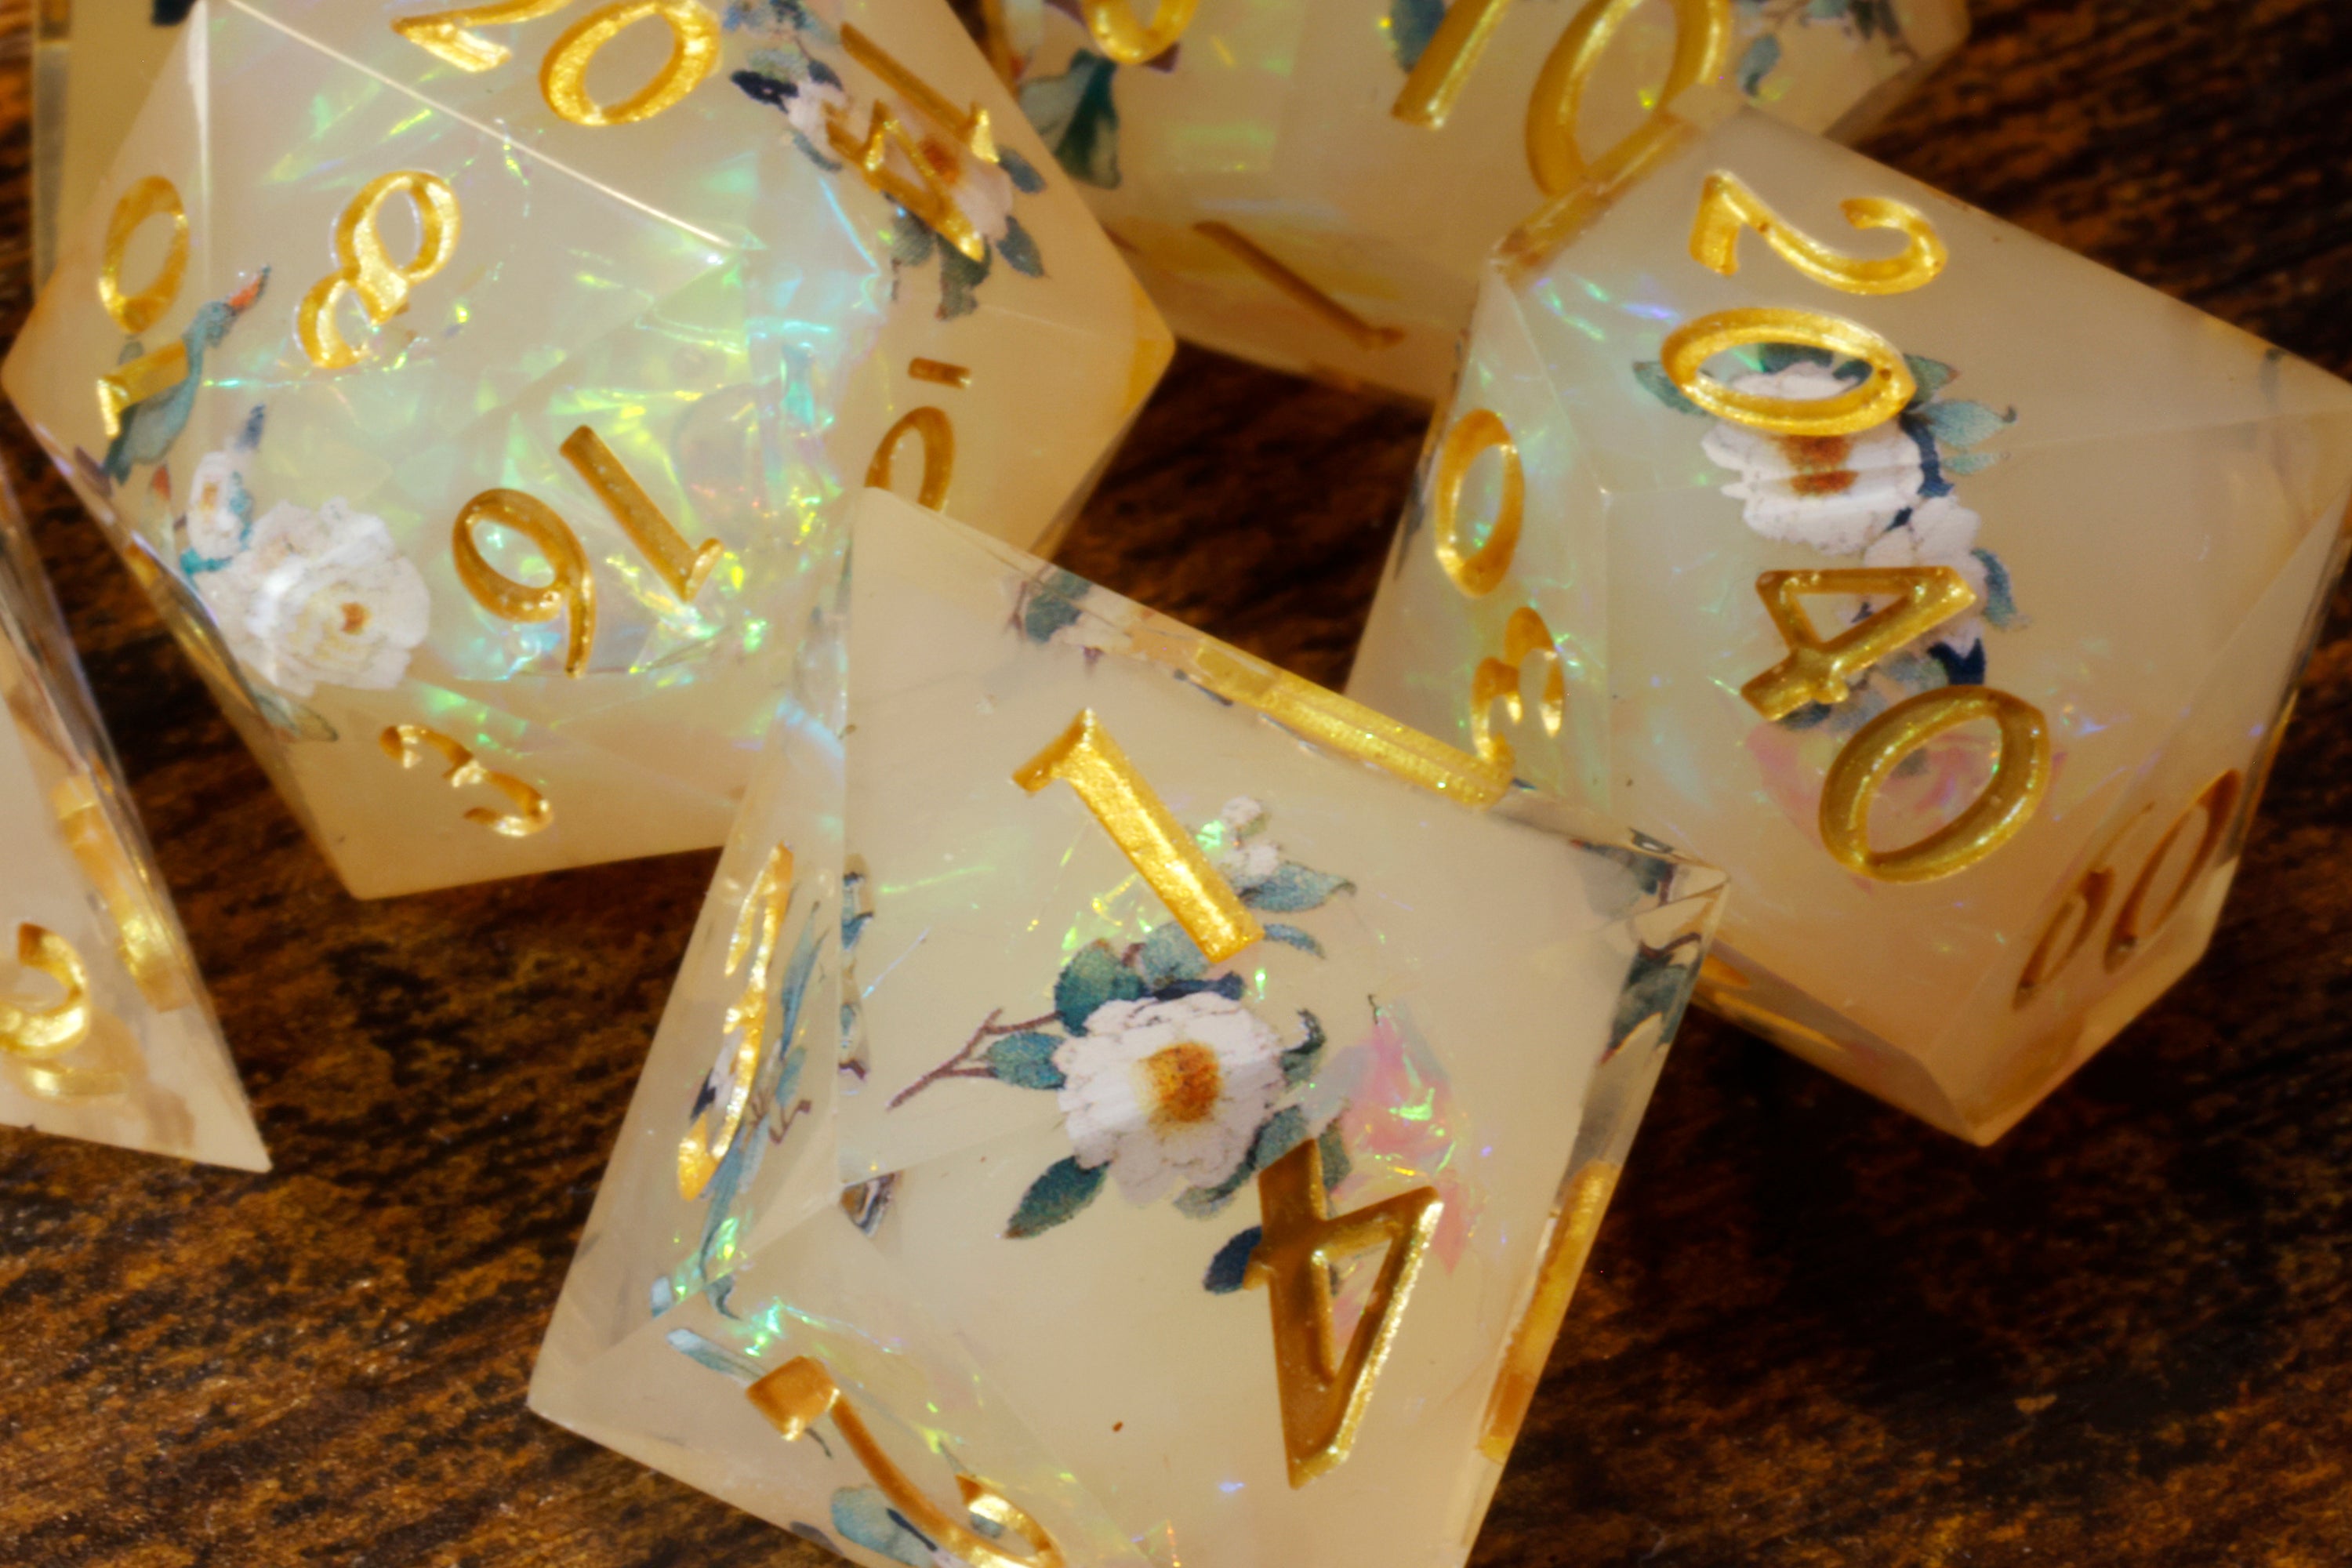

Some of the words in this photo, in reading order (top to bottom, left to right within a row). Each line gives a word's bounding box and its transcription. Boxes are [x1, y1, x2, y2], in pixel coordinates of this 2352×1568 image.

[296, 169, 461, 370] 8
[822, 21, 1000, 263] 14
[98, 175, 190, 437] 10
[1660, 171, 1949, 437] 20
[451, 424, 725, 679] 16
[379, 723, 553, 837] 3
[1011, 708, 1265, 964] 1
[1740, 565, 2049, 884] 40
[1242, 1137, 1444, 1490] 4
